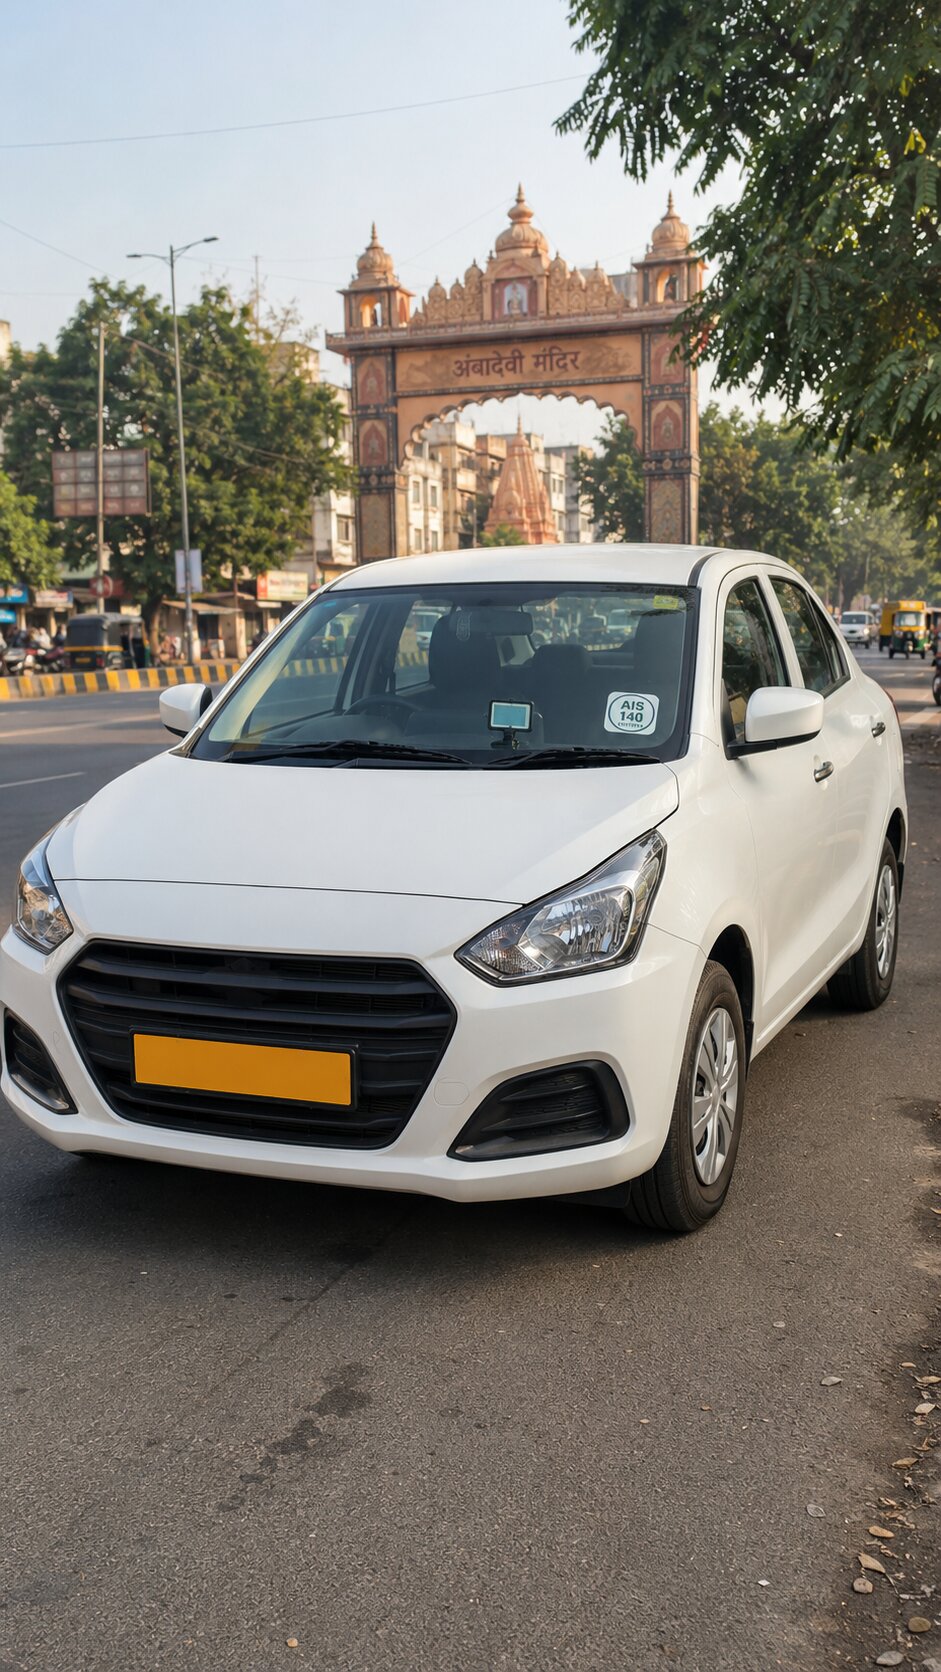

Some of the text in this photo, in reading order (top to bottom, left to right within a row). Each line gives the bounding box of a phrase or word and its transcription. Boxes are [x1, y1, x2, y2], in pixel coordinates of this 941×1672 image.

[453, 345, 580, 377] अंबादेवी मंदिर
[620, 700, 645, 711] AIS
[620, 711, 644, 722] 140
